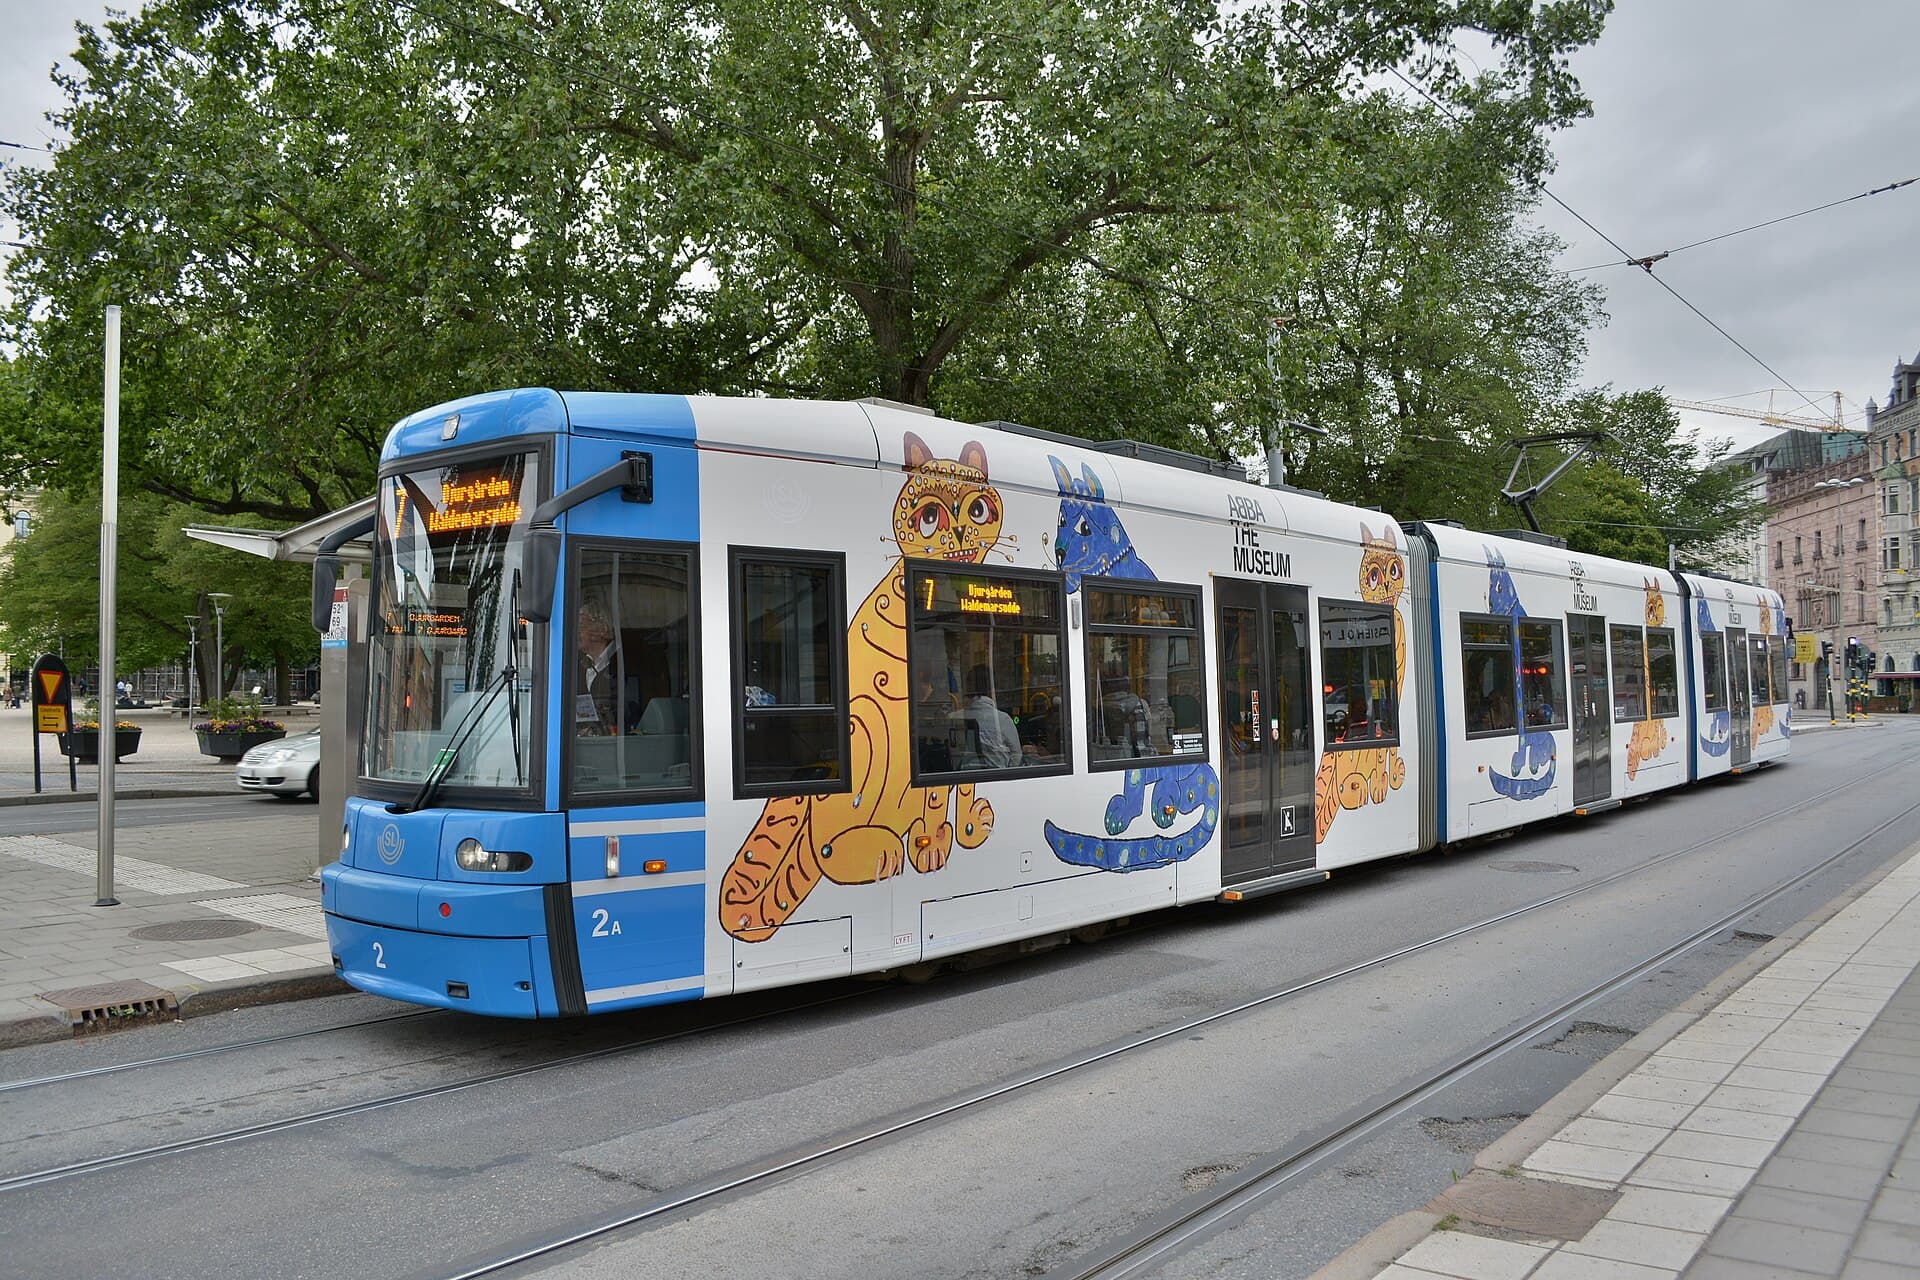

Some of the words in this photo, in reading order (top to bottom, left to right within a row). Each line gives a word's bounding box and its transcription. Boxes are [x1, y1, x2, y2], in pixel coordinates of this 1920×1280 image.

[443, 477, 510, 505] Djurgården
[394, 488, 407, 539] 7
[428, 501, 522, 531] Waldemarsudde
[1228, 494, 1266, 523] ABBA
[1230, 520, 1259, 547] THE
[1233, 546, 1291, 578] MUSEUM
[925, 579, 934, 610] 7
[968, 584, 1013, 599] Djurgården
[961, 598, 1021, 614] Waldemarsudde
[384, 830, 396, 847] SL
[896, 936, 910, 944] LYFT
[373, 942, 386, 969] 2
